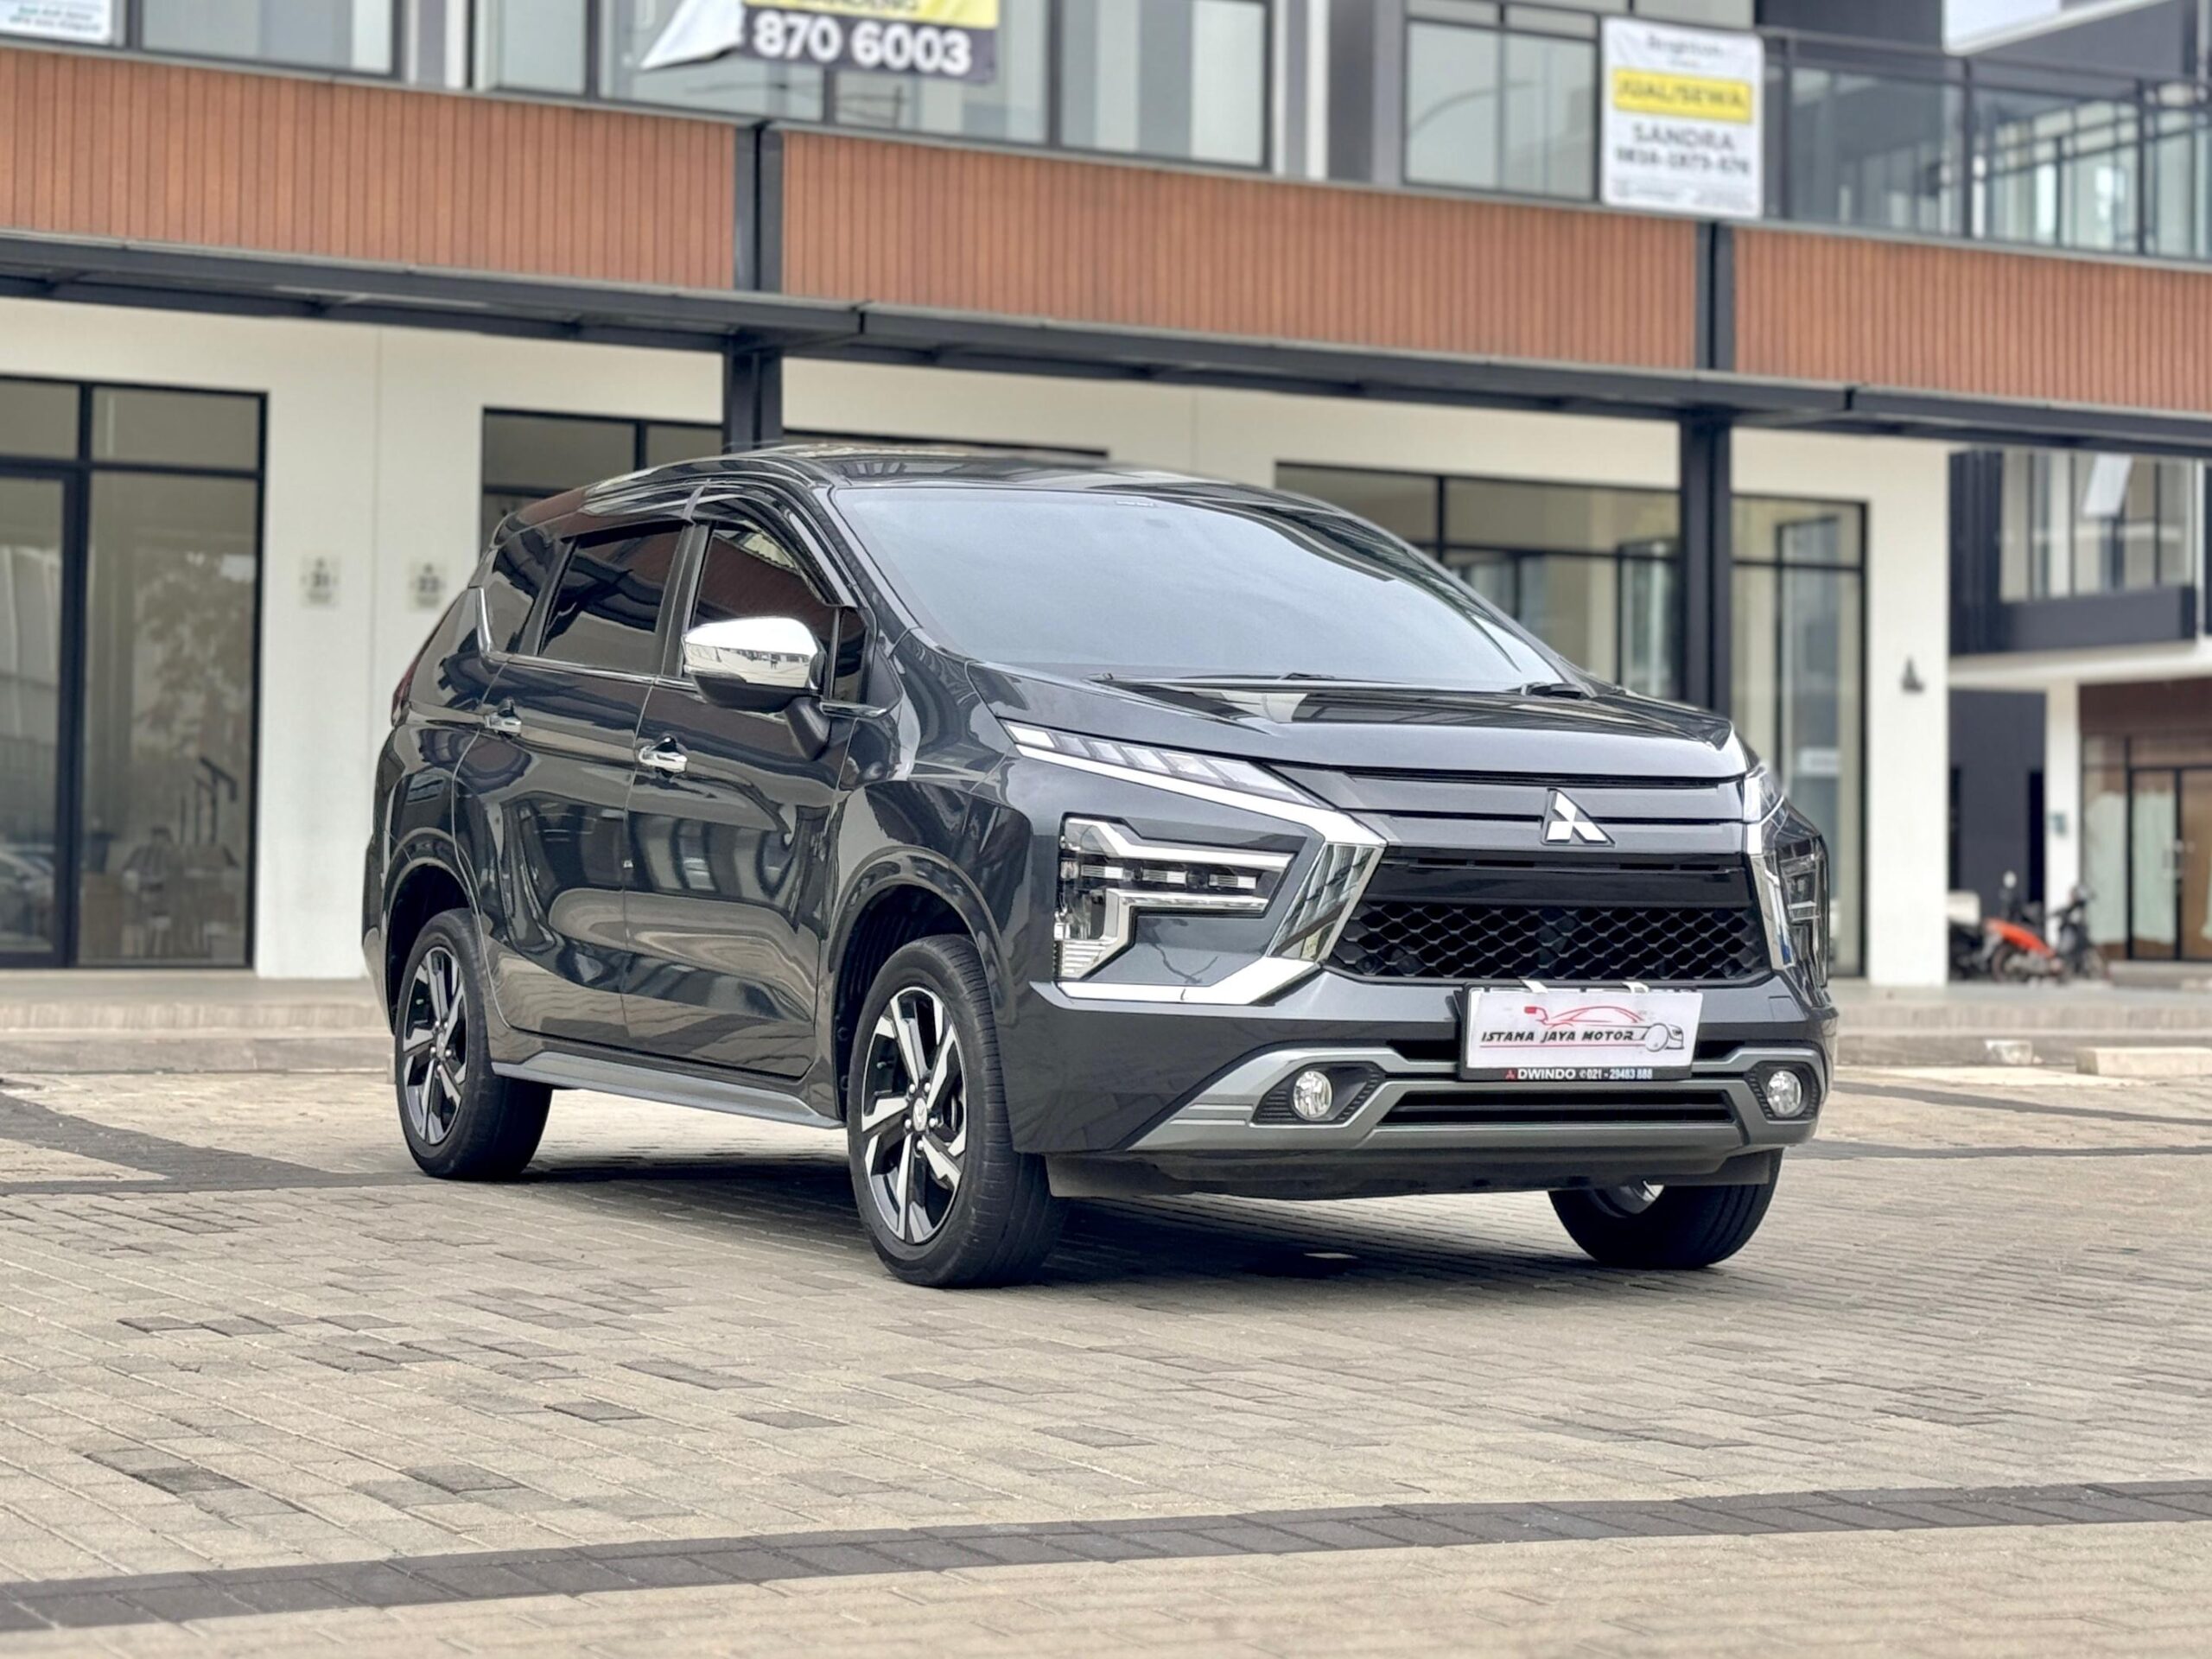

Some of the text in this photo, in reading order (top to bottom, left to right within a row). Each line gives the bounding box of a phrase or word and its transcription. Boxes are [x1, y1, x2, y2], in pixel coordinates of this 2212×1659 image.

[753, 10, 972, 76] 870 6003
[1632, 123, 1736, 152] SANDRA
[1540, 1031, 1576, 1044] JAYA
[1581, 1030, 1634, 1042] MOTOR
[1517, 1068, 1577, 1080] DWINDO
